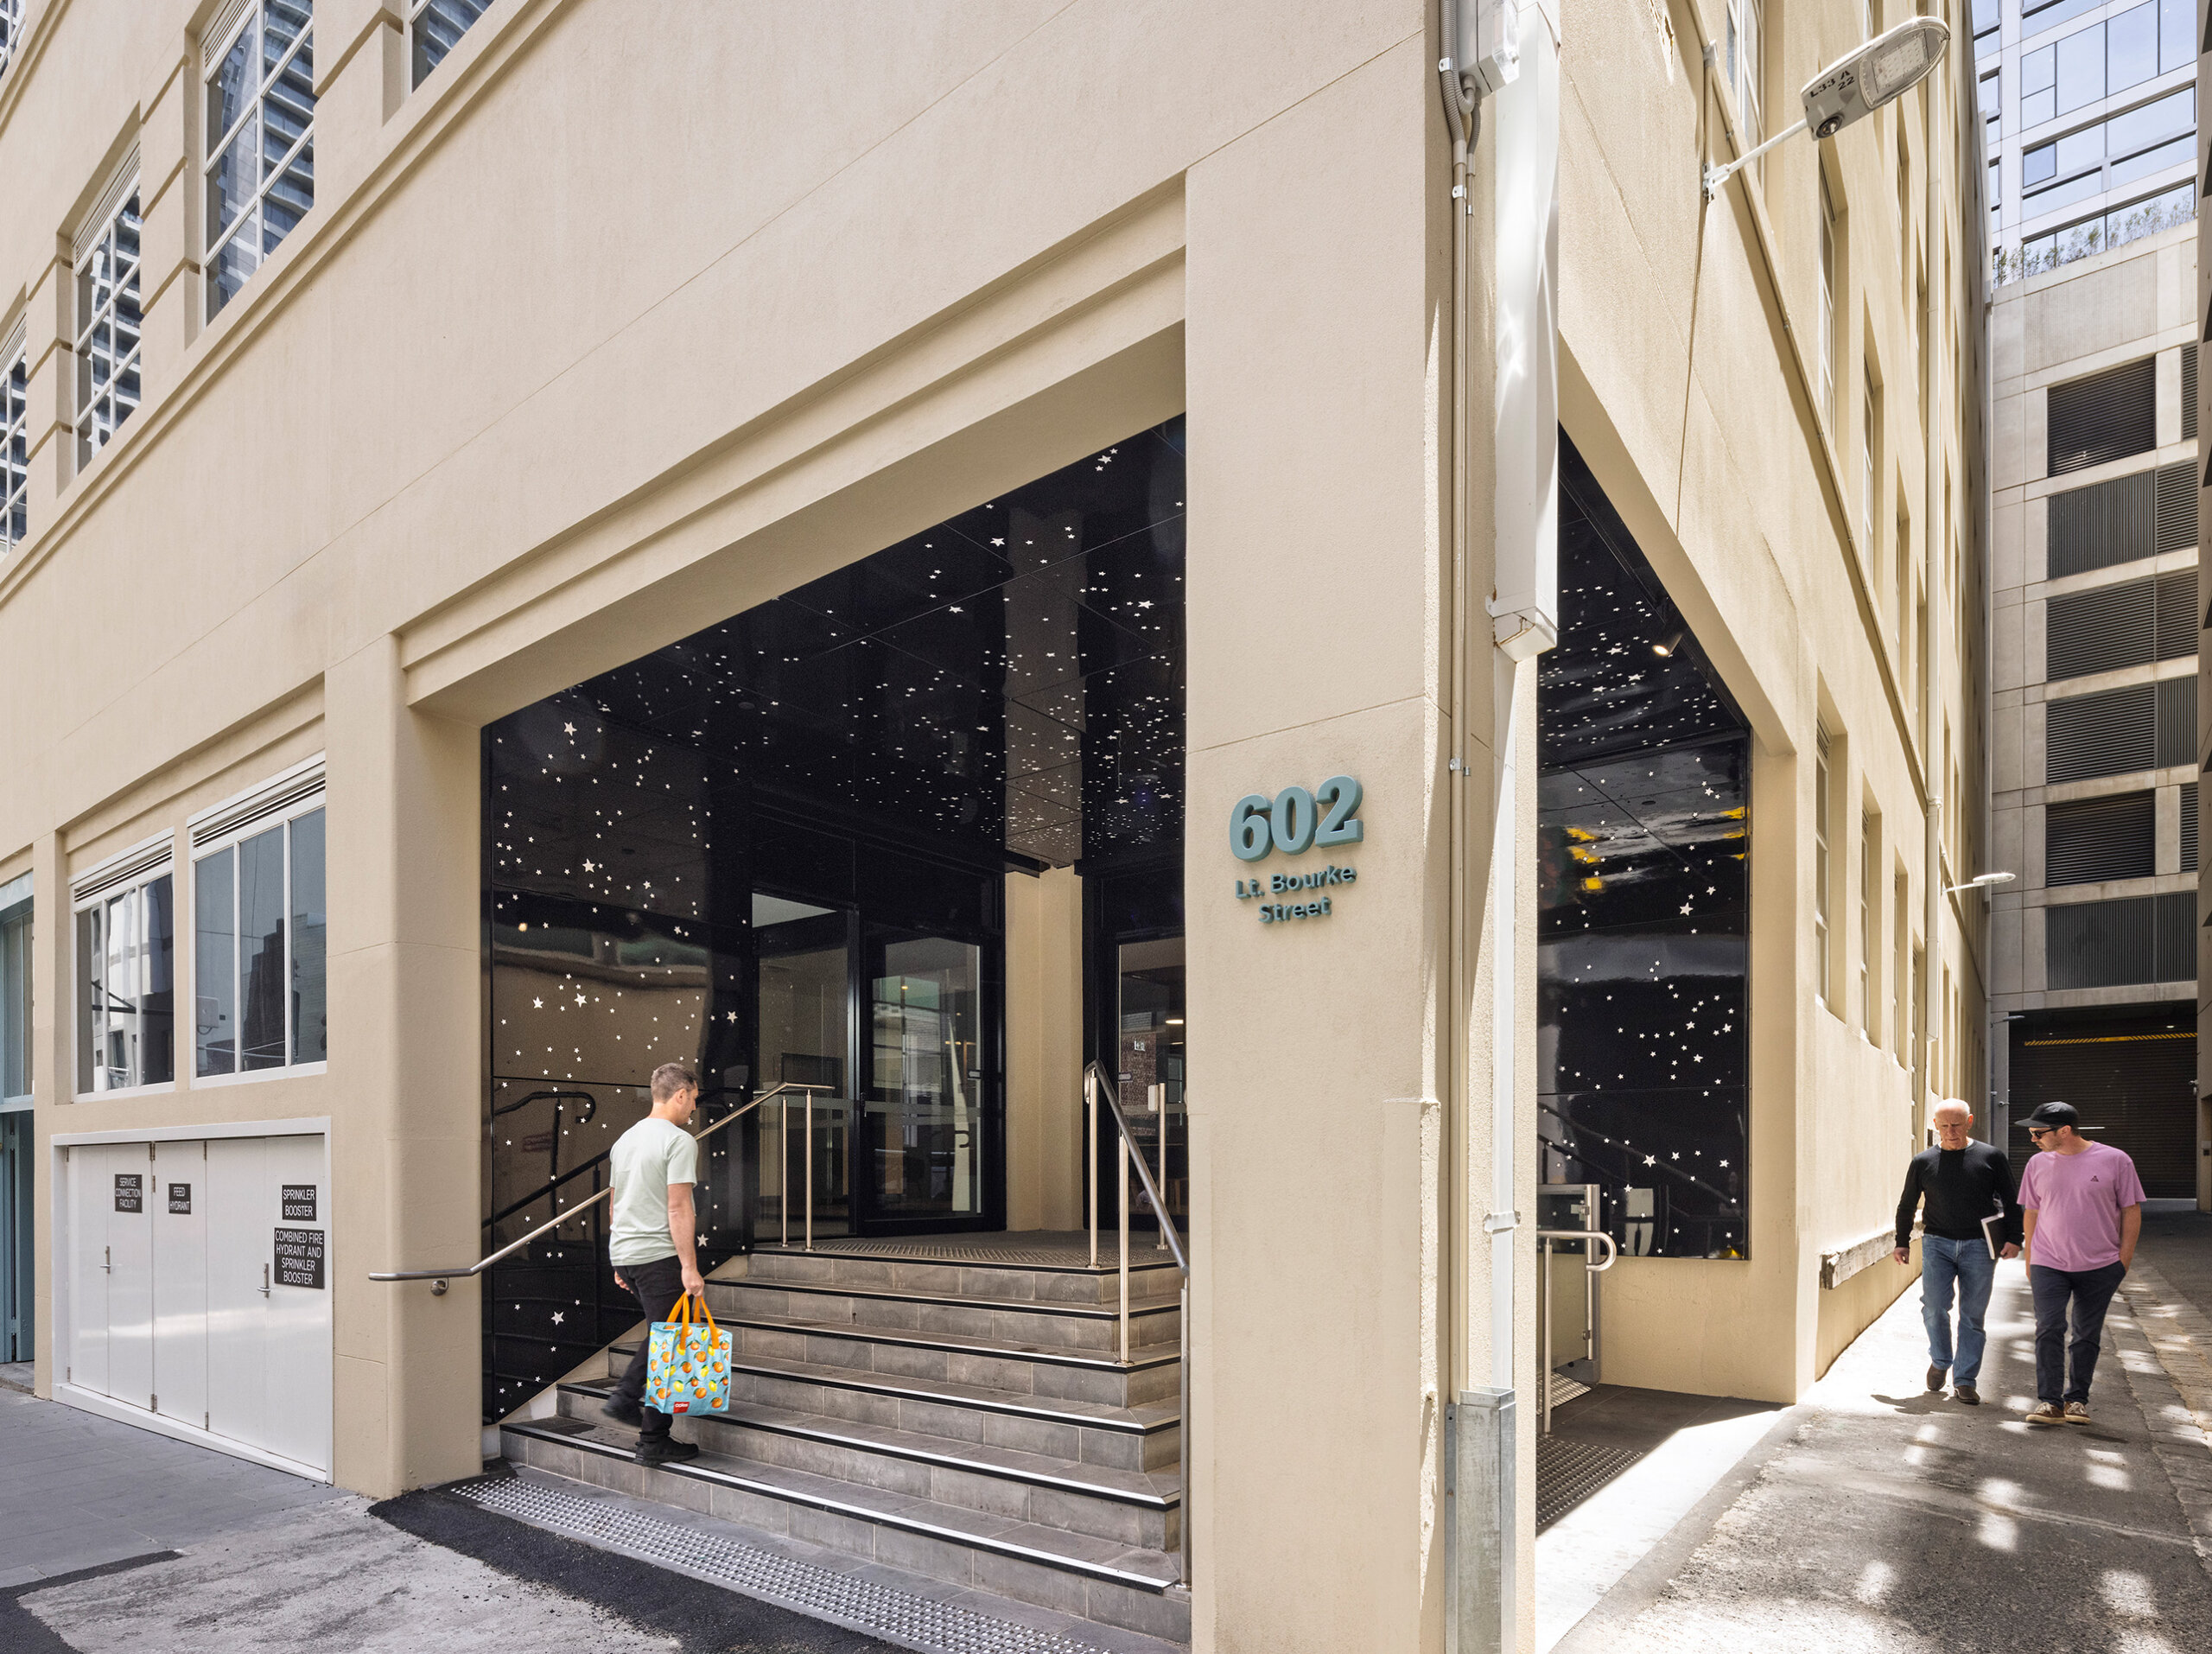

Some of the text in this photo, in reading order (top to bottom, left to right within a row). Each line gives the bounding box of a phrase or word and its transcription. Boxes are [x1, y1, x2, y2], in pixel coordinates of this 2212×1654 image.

[1230, 775, 1363, 862] 602
[1236, 865, 1357, 900] Lt. Bourke
[1258, 896, 1332, 924] Street
[119, 1177, 137, 1186] SERVICE
[115, 1188, 142, 1198] CONNECTION
[173, 1186, 186, 1197] FEED
[283, 1189, 315, 1200] SPRINKLER
[118, 1199, 137, 1208] FACILITY
[168, 1200, 190, 1211] HYDRANT
[285, 1205, 313, 1217] BOOSTER
[275, 1230, 323, 1244] COMBINED FIRE
[276, 1244, 322, 1258] HYDRANT AND
[281, 1256, 315, 1271] SPRINKLER
[283, 1270, 314, 1285] BOOSTER
